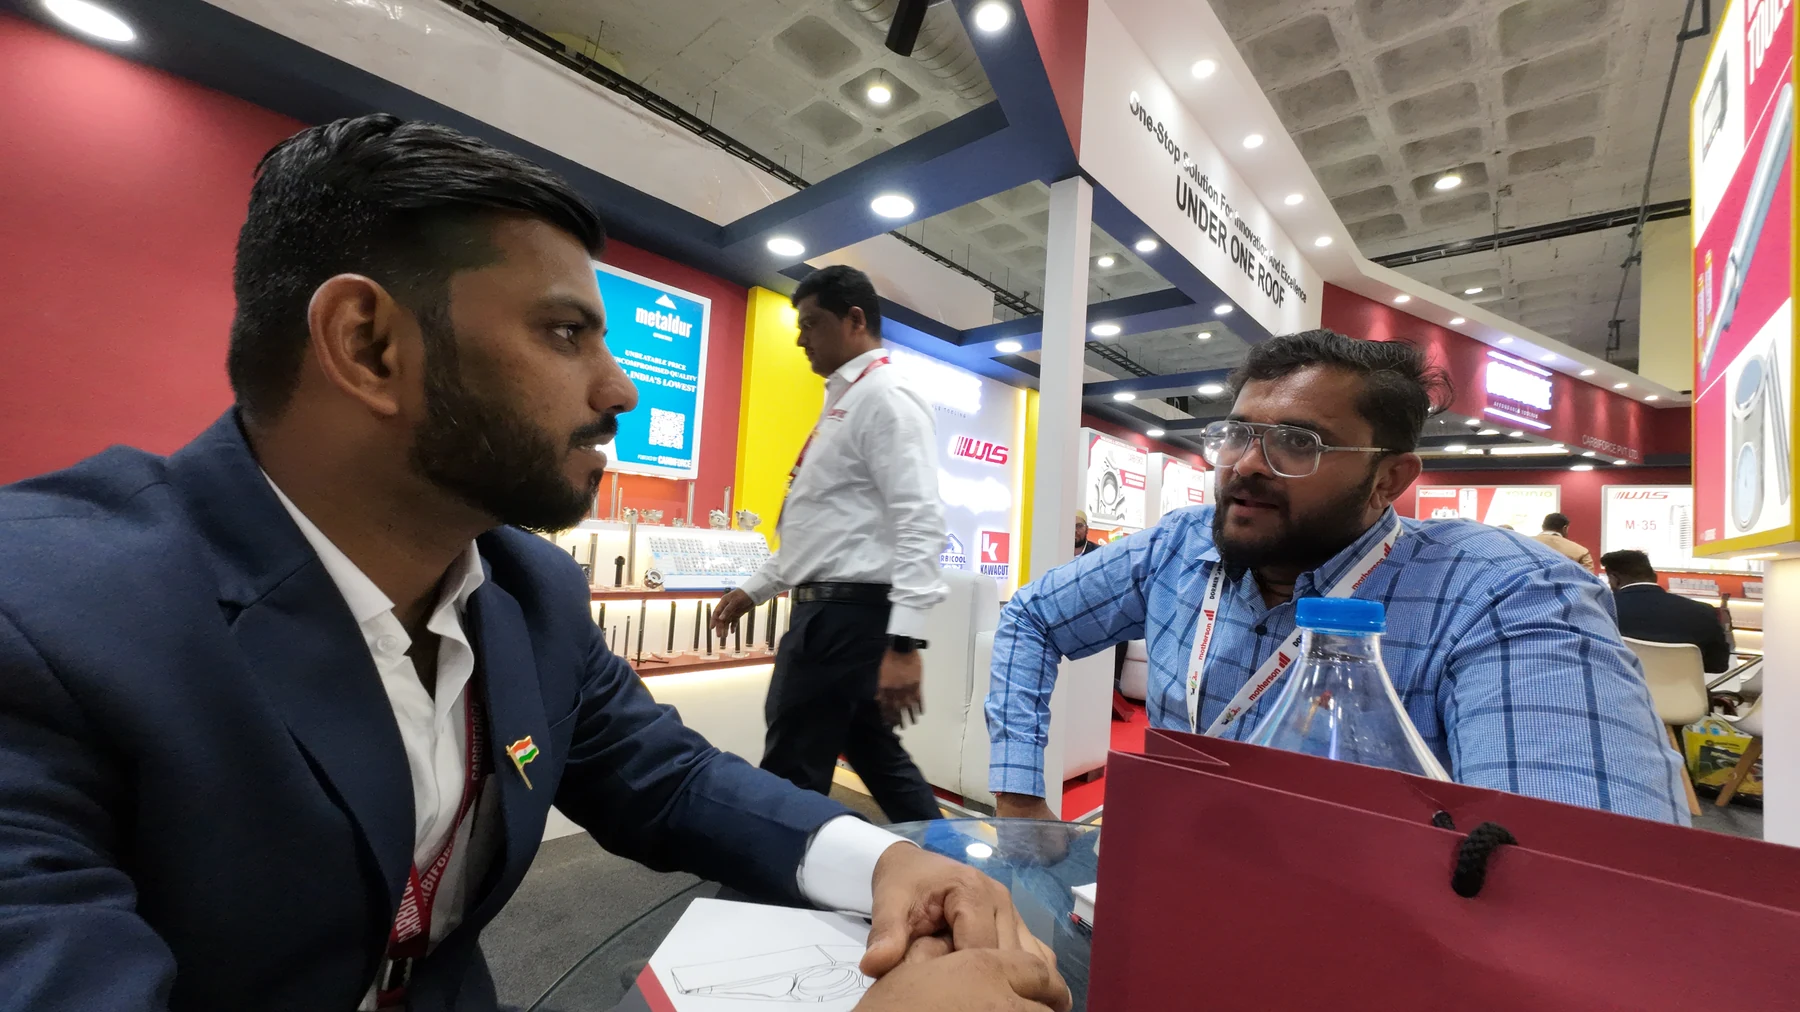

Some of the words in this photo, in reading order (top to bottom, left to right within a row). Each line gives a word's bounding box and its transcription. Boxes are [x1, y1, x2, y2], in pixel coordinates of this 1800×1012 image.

[1129, 91, 1181, 164] One-Stop
[1183, 152, 1219, 206] Solution
[1280, 264, 1307, 303] Excellence
[1176, 174, 1227, 254] UNDER
[1230, 234, 1256, 281] ONE
[1257, 262, 1286, 308] ROOF
[635, 307, 693, 338] metaldur
[613, 356, 670, 375] NCOMPROMISED
[624, 349, 668, 366] UNBEATABLE
[667, 361, 687, 371] PRICE
[630, 370, 662, 385] INDIA'S
[662, 378, 697, 393] LOWEST
[1581, 434, 1617, 452] CARBIFORCE
[1625, 520, 1657, 531] M-35
[980, 564, 1009, 576] KAWACUT
[1351, 557, 1385, 590] motherson
[1198, 623, 1212, 661] motherson
[1248, 667, 1281, 702] motherson
